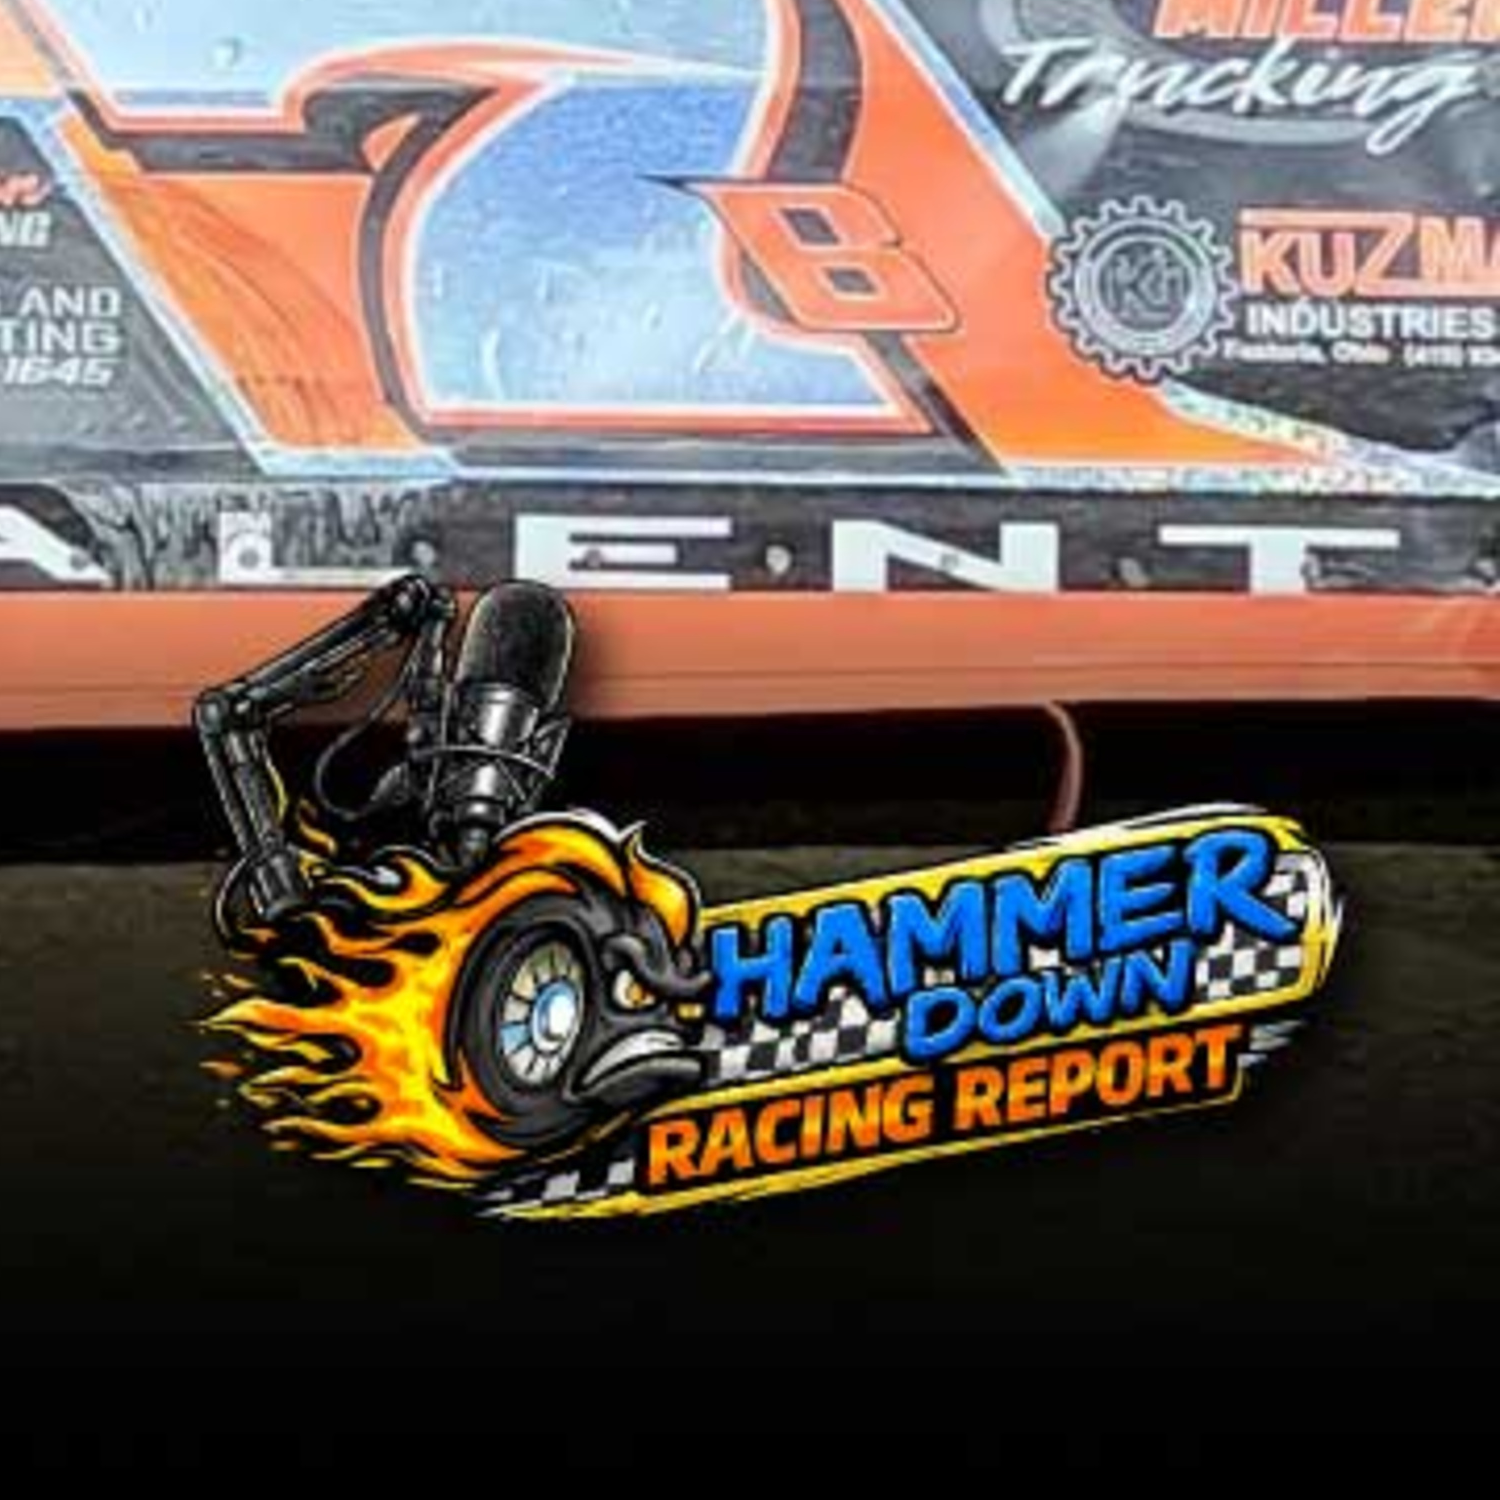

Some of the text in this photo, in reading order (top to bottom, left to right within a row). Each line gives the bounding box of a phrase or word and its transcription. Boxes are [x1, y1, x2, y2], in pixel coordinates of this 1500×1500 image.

[1000, 35, 1482, 155] Trucking
[22, 284, 120, 316] AND
[1246, 303, 1496, 339] INDUSTRIES
